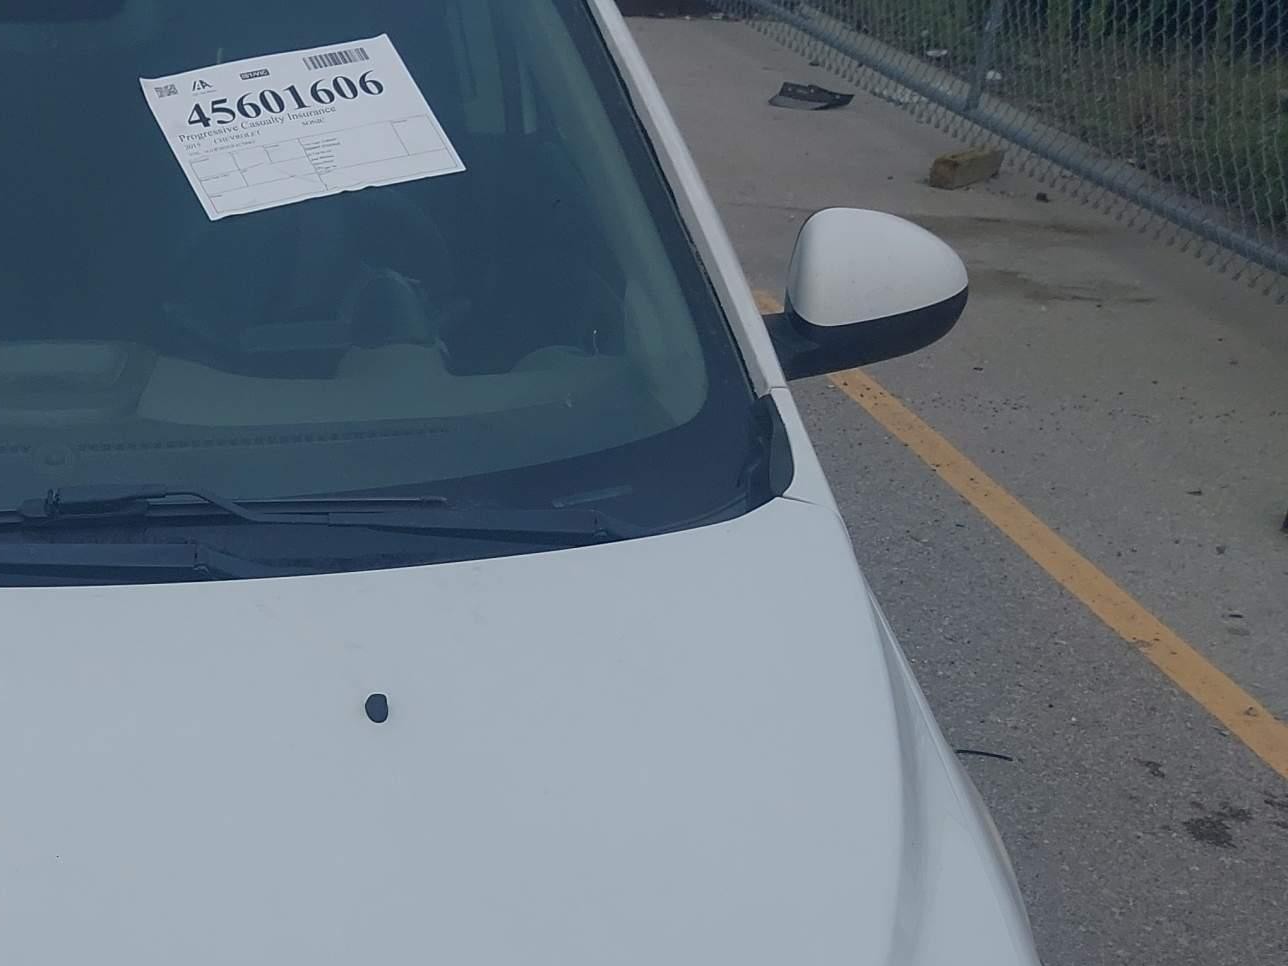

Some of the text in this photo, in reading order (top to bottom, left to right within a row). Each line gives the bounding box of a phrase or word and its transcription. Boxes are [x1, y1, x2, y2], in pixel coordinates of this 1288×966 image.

[186, 69, 385, 129] 45601606
[178, 105, 337, 143] Progressive Casualty Insurance
